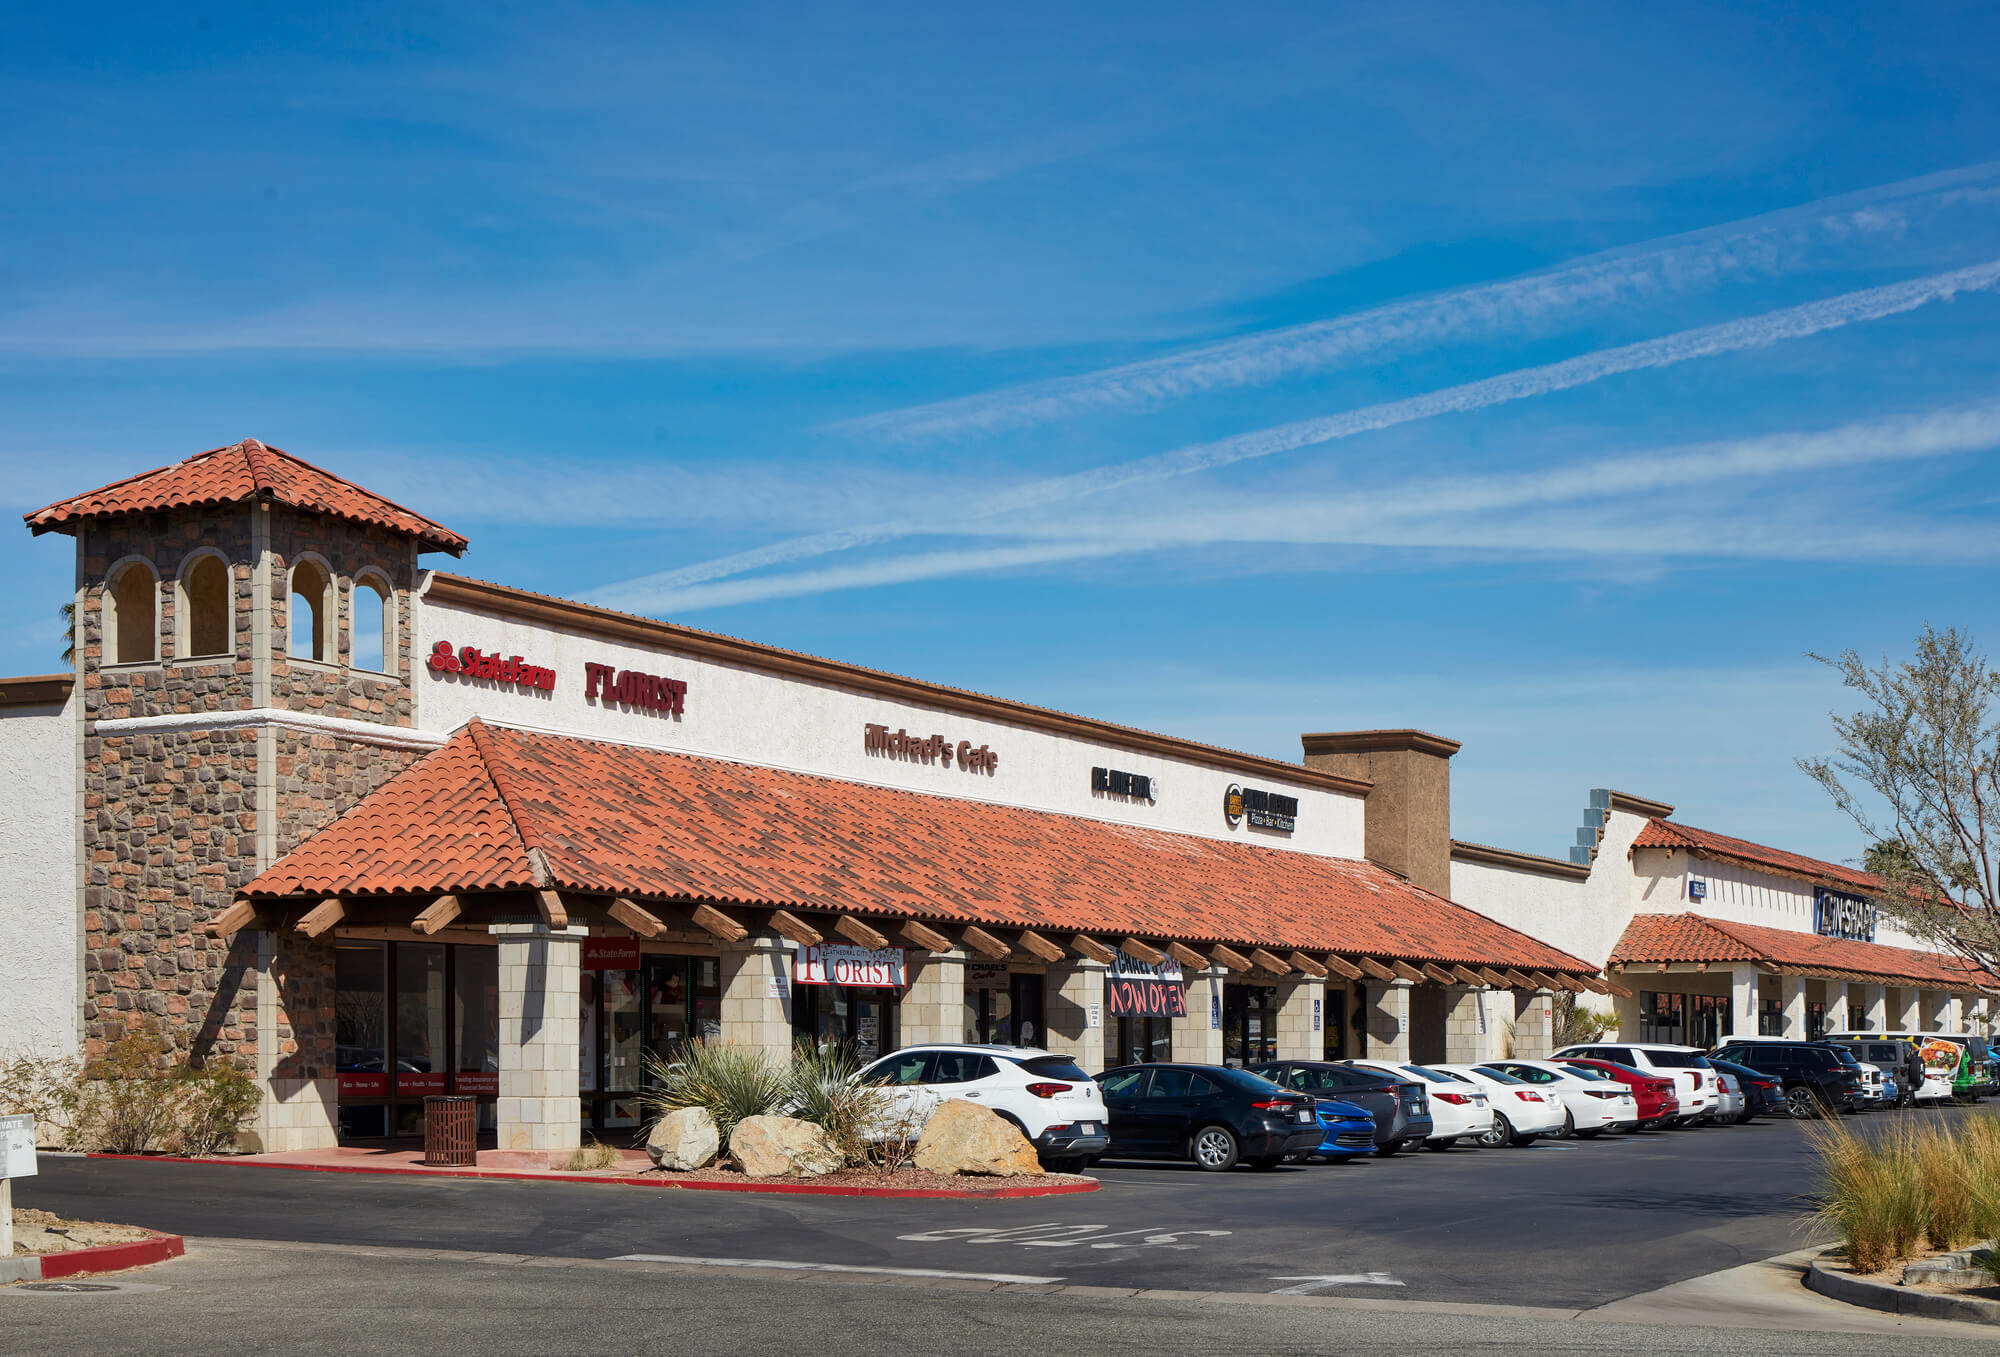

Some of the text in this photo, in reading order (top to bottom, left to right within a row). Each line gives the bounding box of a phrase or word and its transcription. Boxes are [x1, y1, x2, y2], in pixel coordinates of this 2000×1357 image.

[585, 662, 687, 714] FLORIST
[865, 723, 998, 769] Michael's Cafe
[1251, 812, 1263, 825] Pizza
[1265, 815, 1273, 827] Bar
[804, 946, 895, 984] FLORIST
[1111, 981, 1186, 1015] NOW OPEN
